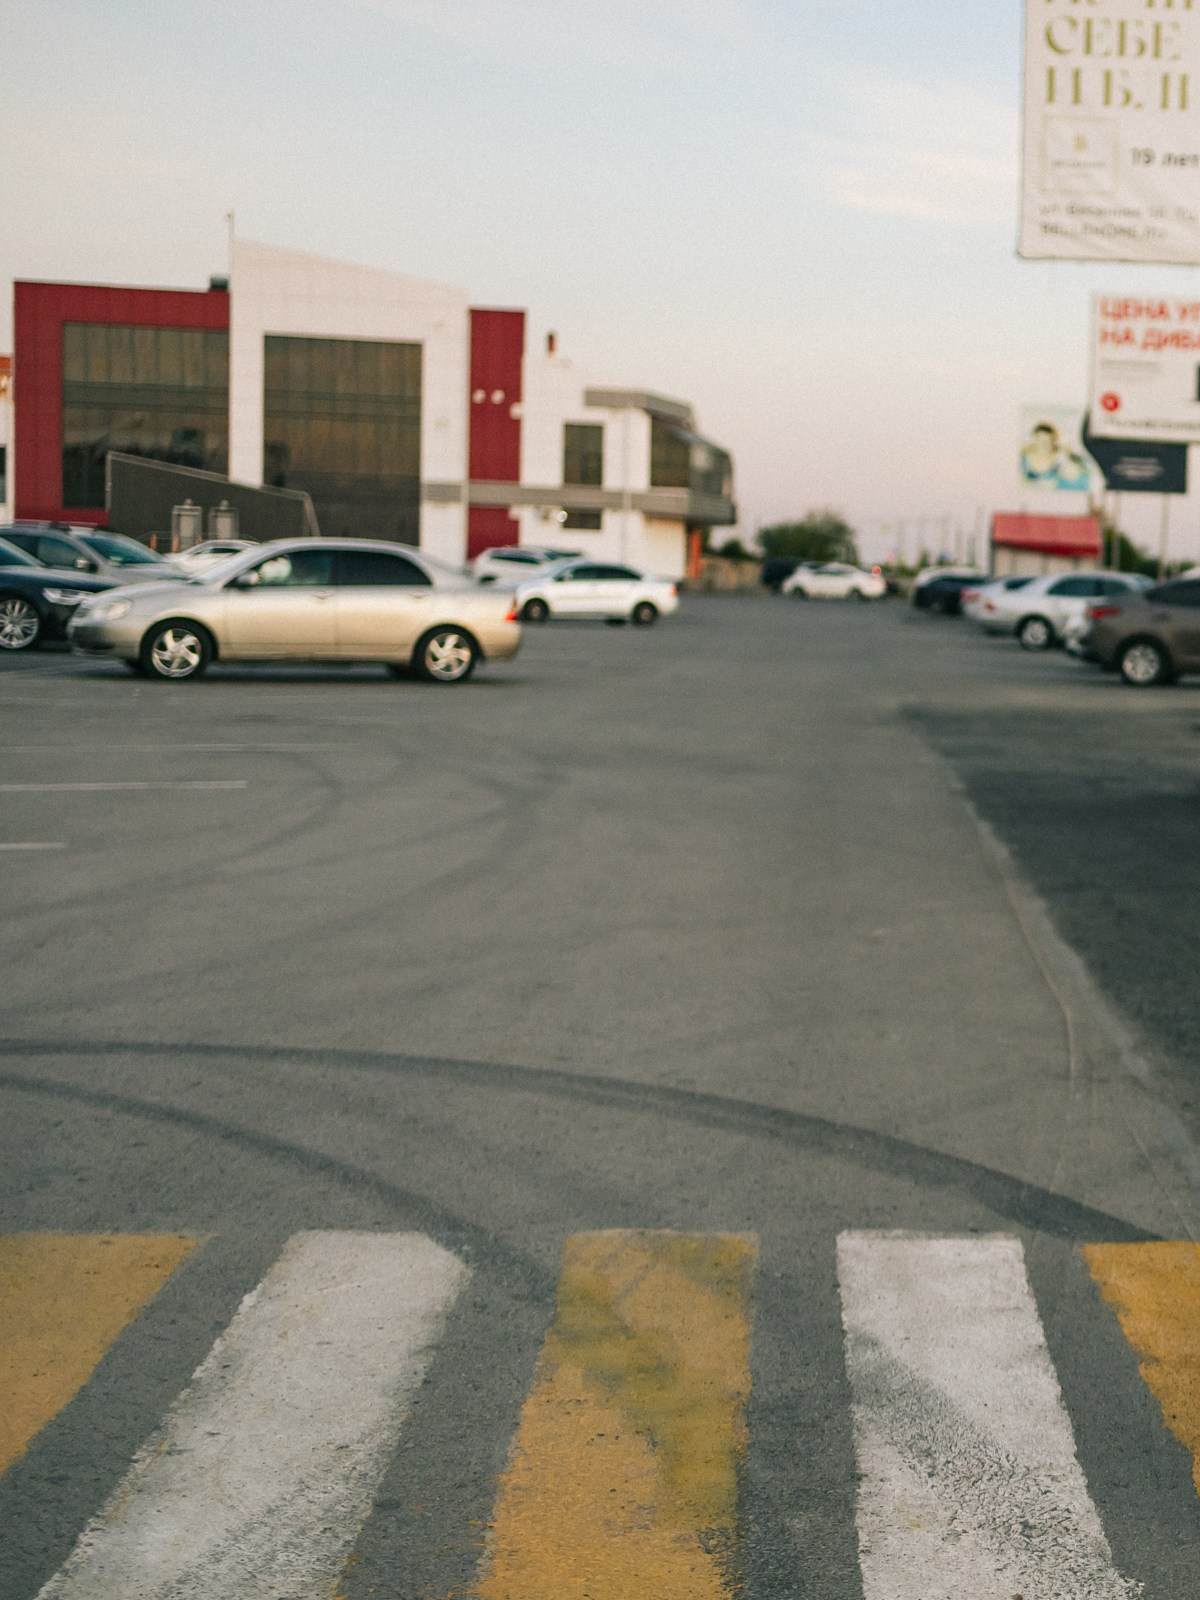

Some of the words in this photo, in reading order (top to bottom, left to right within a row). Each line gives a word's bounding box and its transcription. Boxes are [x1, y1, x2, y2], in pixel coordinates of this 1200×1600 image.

[1044, 16, 1181, 60] СЕБЕ
[1161, 152, 1200, 169] лет
[1100, 297, 1169, 322] ЦЕНА
[1100, 327, 1135, 347] НА
